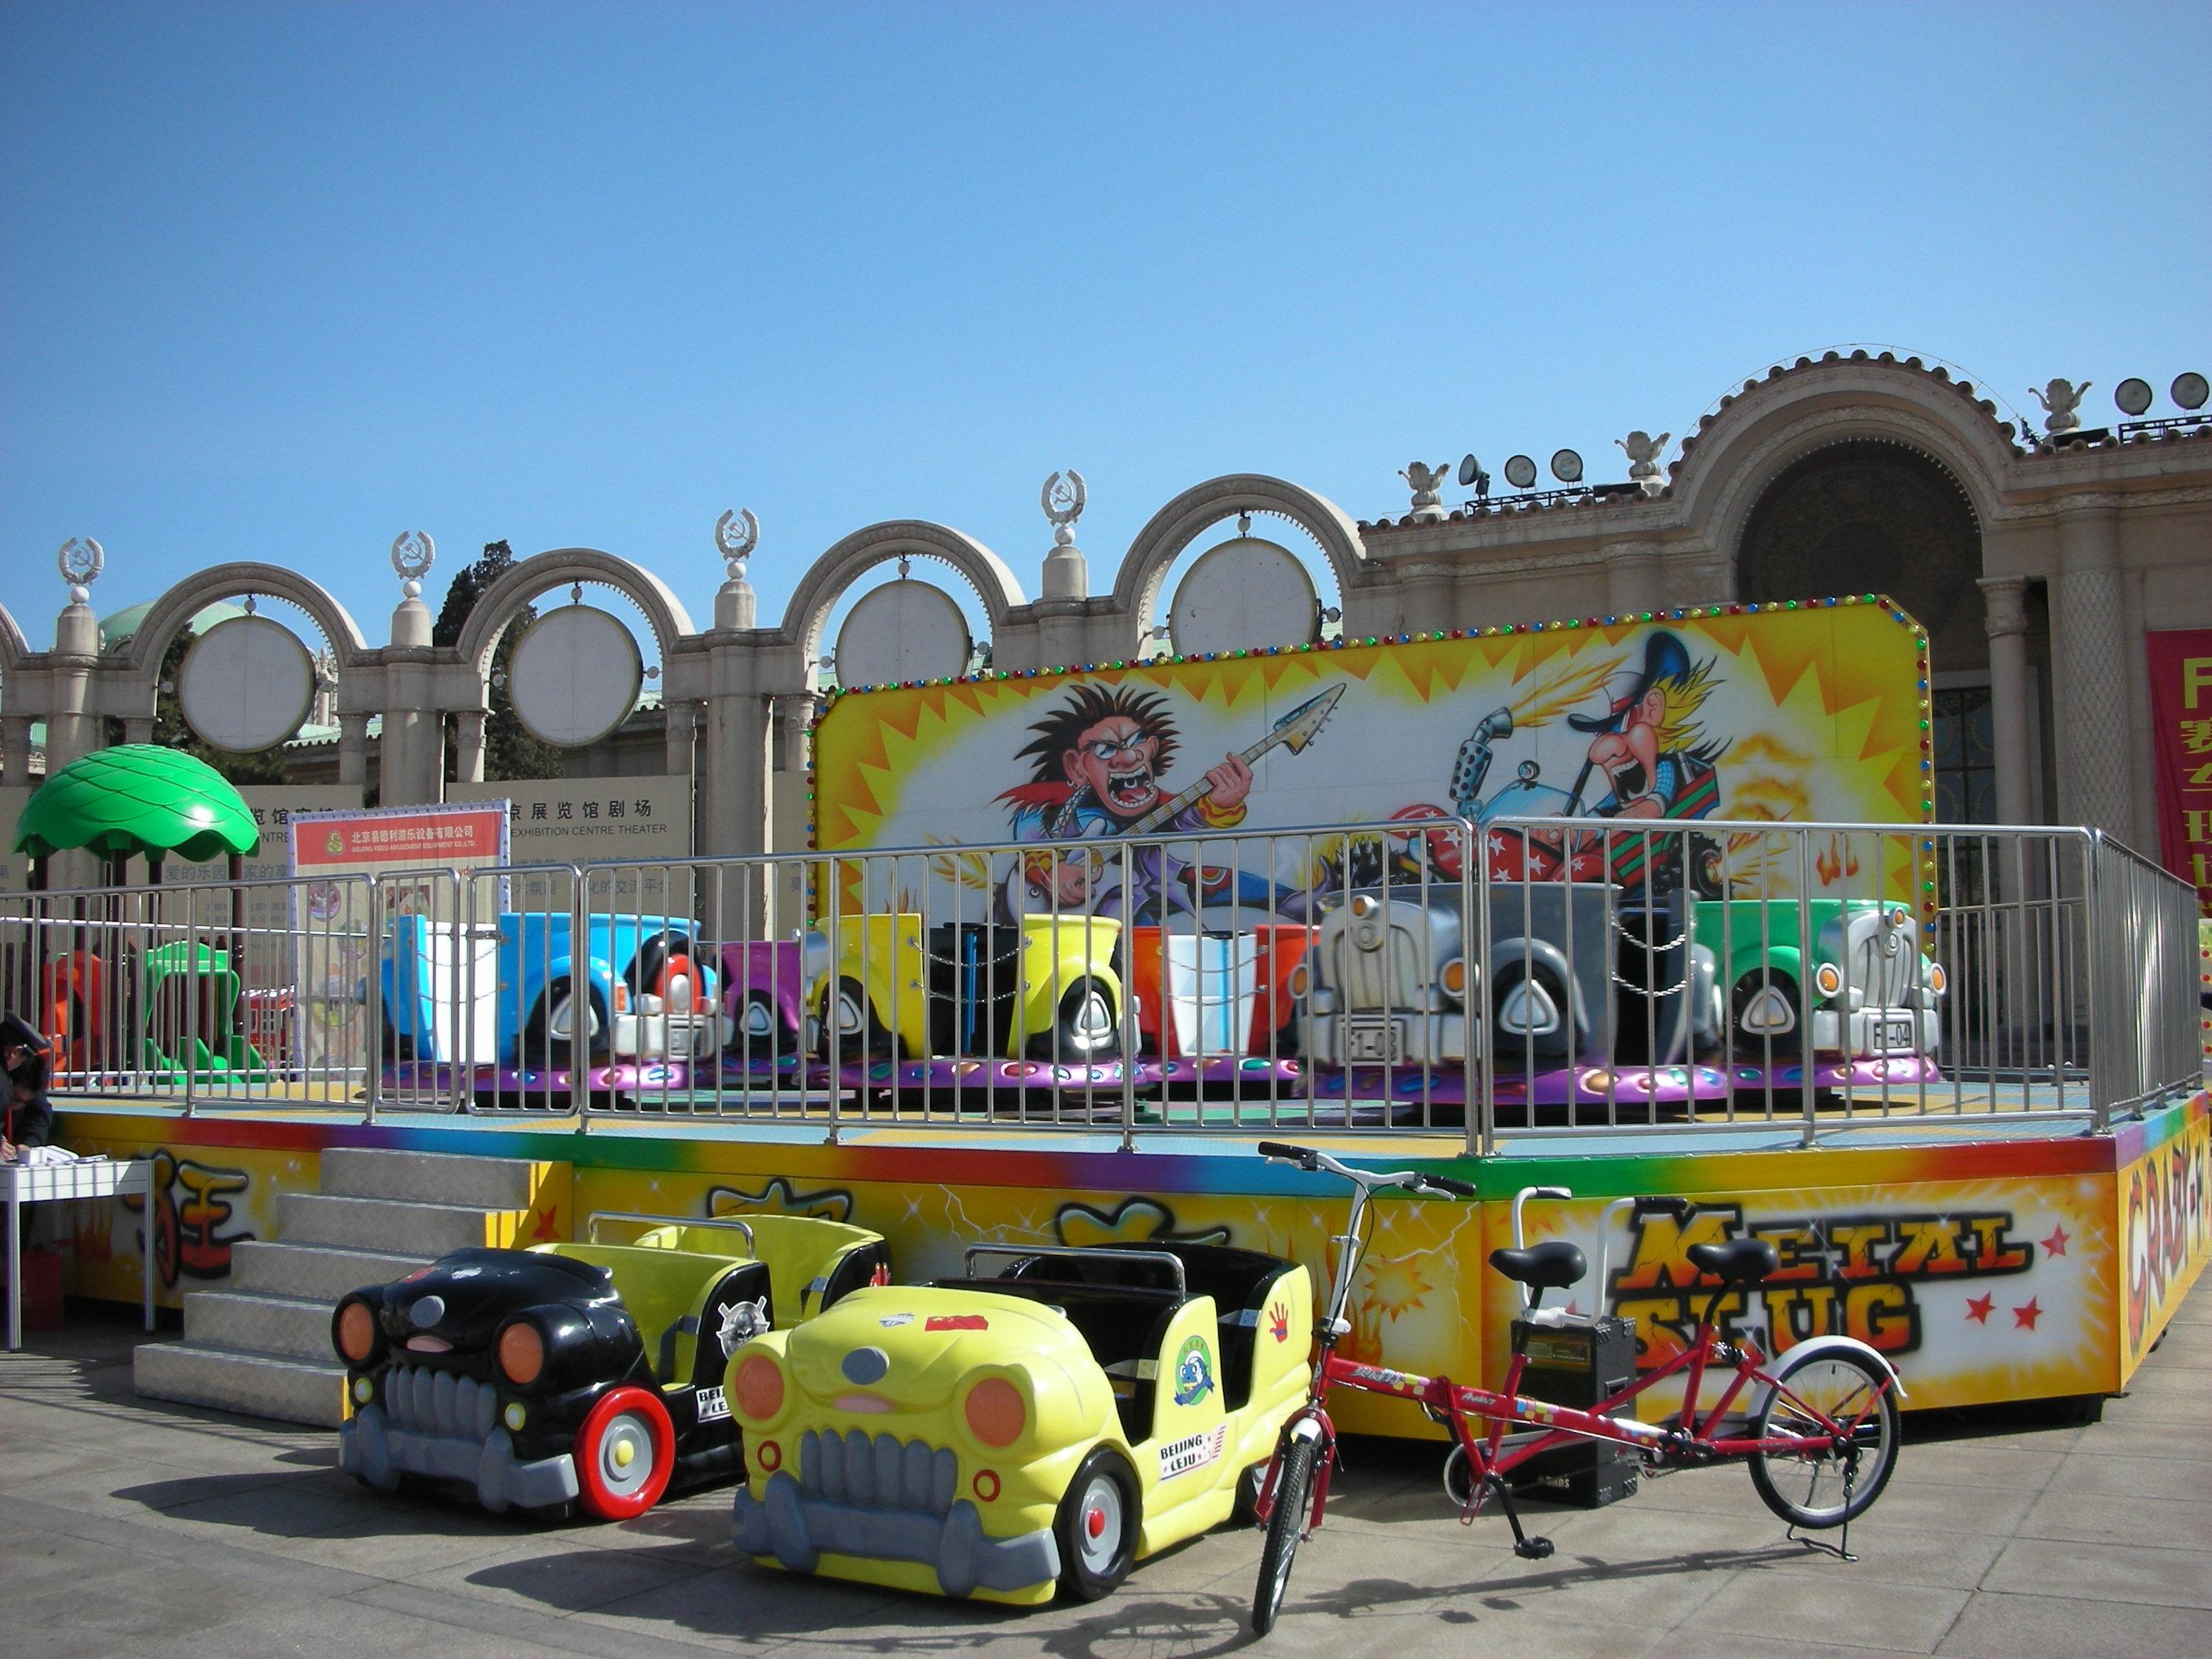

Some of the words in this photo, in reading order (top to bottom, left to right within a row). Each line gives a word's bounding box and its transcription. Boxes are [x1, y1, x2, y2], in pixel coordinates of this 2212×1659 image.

[511, 826, 569, 837] EXHIBITION
[572, 826, 614, 836] CENTRE
[619, 824, 667, 834] THEATER
[260, 833, 288, 843] NTRE
[1873, 1023, 1910, 1048] F-04
[698, 1387, 724, 1403] BEI
[711, 1401, 729, 1413] LE
[1160, 1434, 1203, 1460] BEIJING
